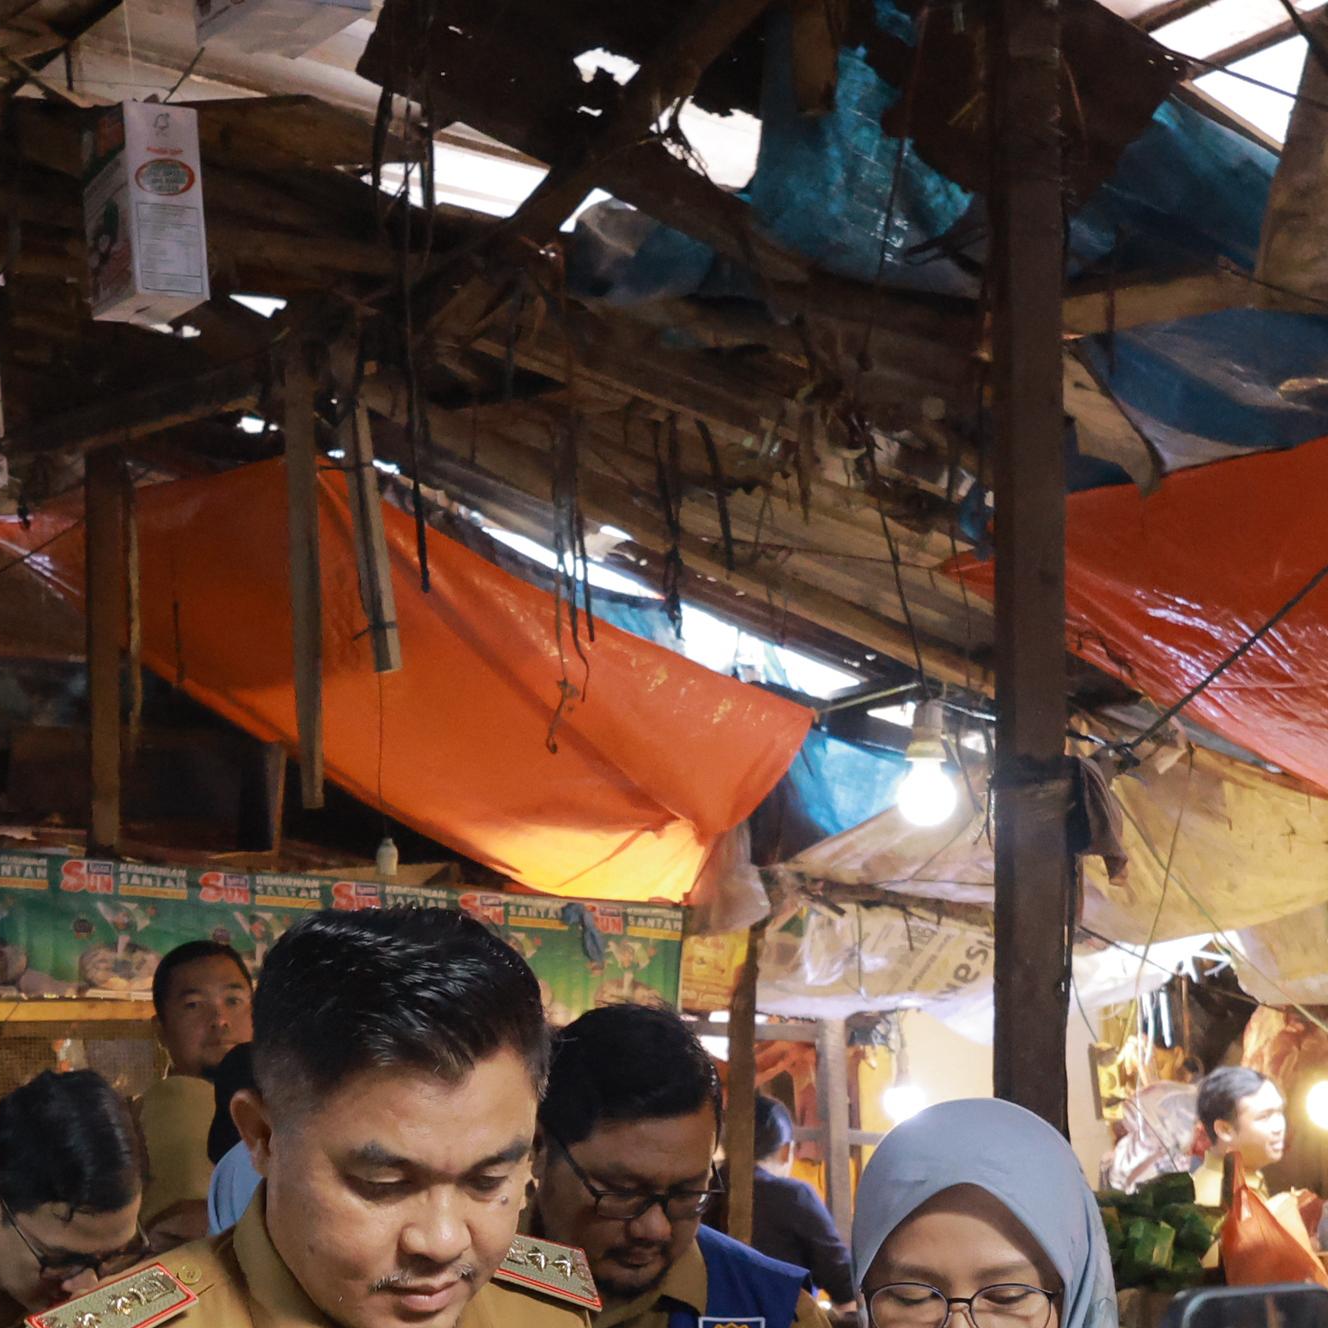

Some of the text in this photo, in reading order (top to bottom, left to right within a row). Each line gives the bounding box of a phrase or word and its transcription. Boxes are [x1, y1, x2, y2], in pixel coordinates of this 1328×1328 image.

[60, 859, 114, 894] SUN
[119, 873, 187, 889] SANTAN
[199, 871, 250, 905] SUN
[509, 904, 562, 920] SANTA
